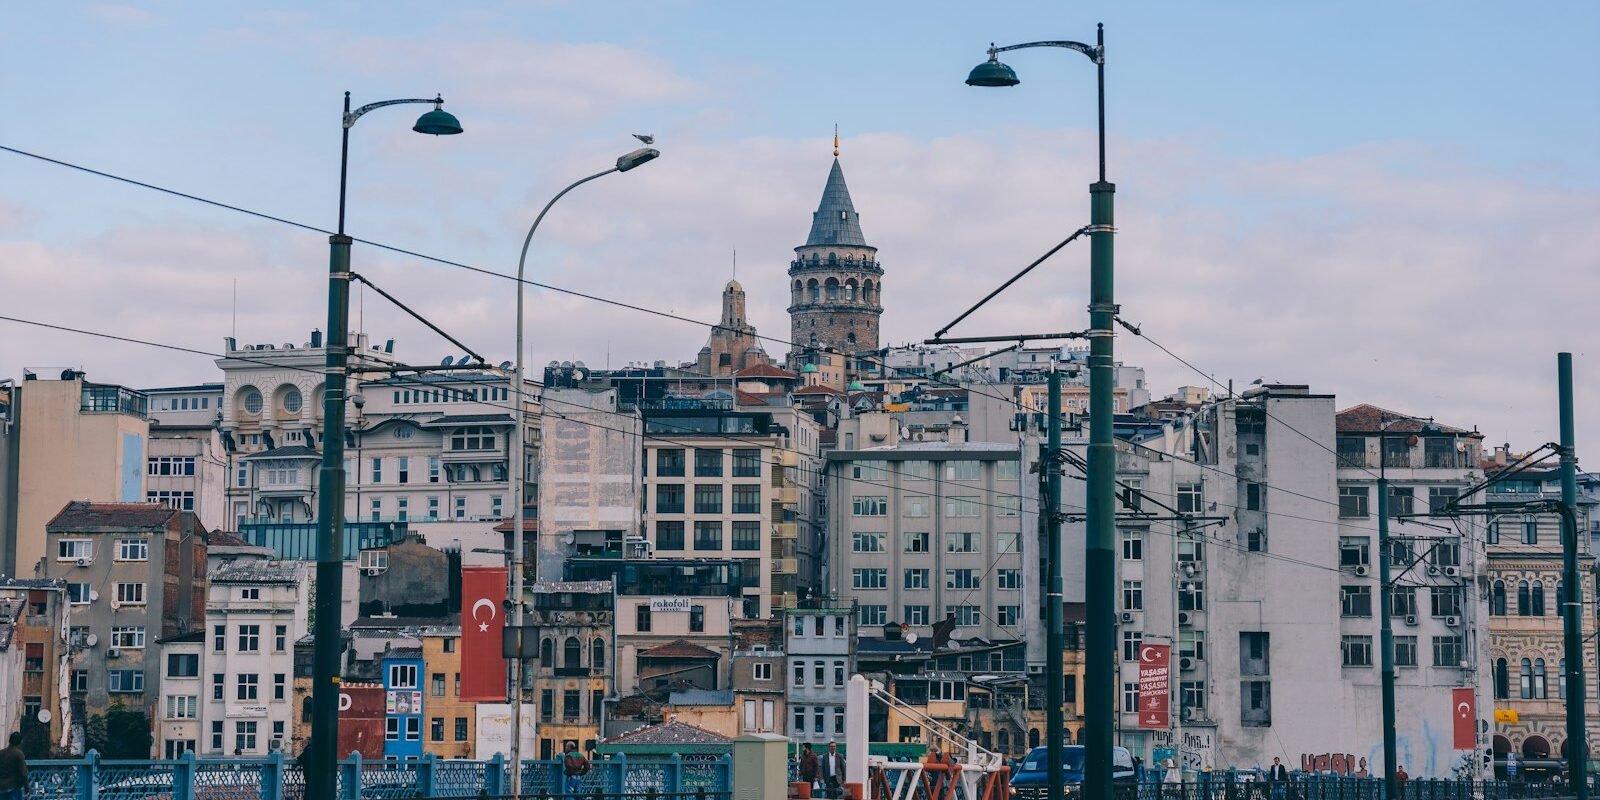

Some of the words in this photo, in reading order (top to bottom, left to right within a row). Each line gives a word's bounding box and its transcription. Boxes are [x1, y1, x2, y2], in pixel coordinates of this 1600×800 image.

[652, 598, 689, 608] rakofoli
[1140, 668, 1168, 678] YAŞASIN
[1140, 681, 1168, 690] YAŞASIN
